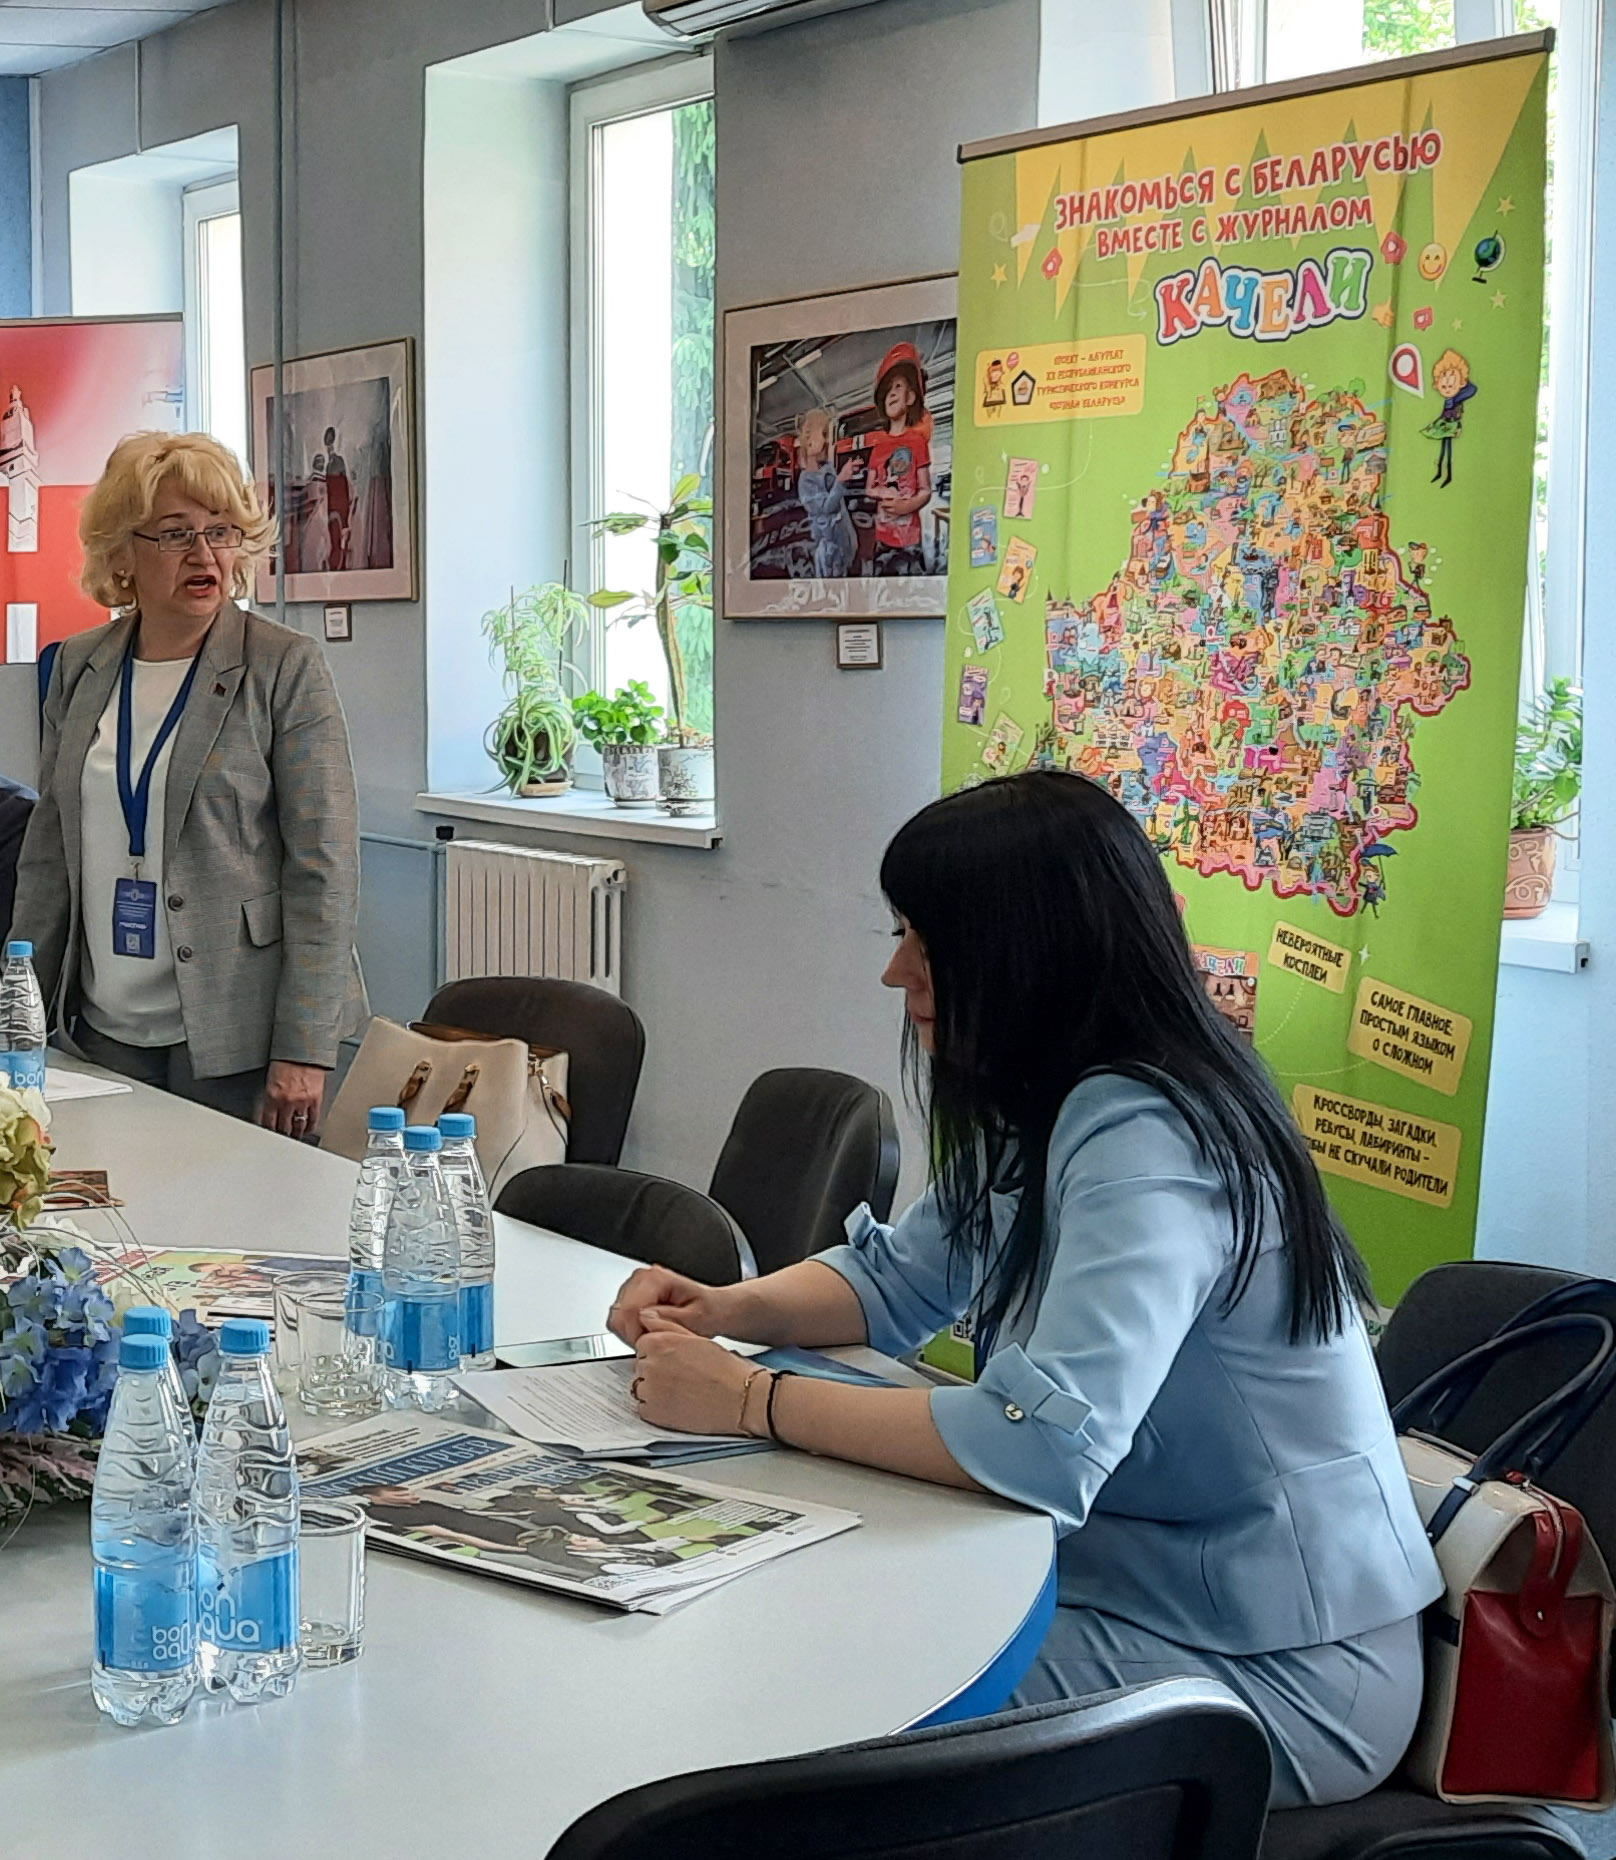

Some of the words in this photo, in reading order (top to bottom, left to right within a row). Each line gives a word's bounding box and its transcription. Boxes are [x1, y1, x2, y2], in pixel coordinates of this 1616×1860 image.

[1055, 167, 1215, 231] ЗНАКОМЬСЯ
[1224, 167, 1241, 196] С
[1253, 131, 1442, 196] БЕЛАРУСЬЮ
[1097, 221, 1183, 259] ВМЕСТЕ
[1191, 214, 1206, 244] С
[1215, 197, 1373, 243] ЖУРНАЛОМ
[1158, 252, 1370, 342] КАЧЕЛИ
[1276, 927, 1344, 968] НЕВЕРОЯТНЫЕ
[1370, 990, 1406, 1017] САМОЕ
[1359, 1009, 1410, 1042] ПРОСТЫМ
[1411, 1030, 1456, 1062] ЯЗЫКОМ
[1372, 1038, 1380, 1052] О
[1382, 1041, 1434, 1075] СЛОЖНОМ
[1313, 1093, 1383, 1133] КРОССВОРДЫ,
[1359, 1130, 1422, 1163] ЛАБИРИНТЫ
[1328, 1142, 1342, 1161] НЕ
[1343, 1148, 1392, 1178] СКУЧАЛИ
[1393, 1165, 1449, 1197] РОДИТЕЛИ
[200, 1611, 260, 1643] qua
